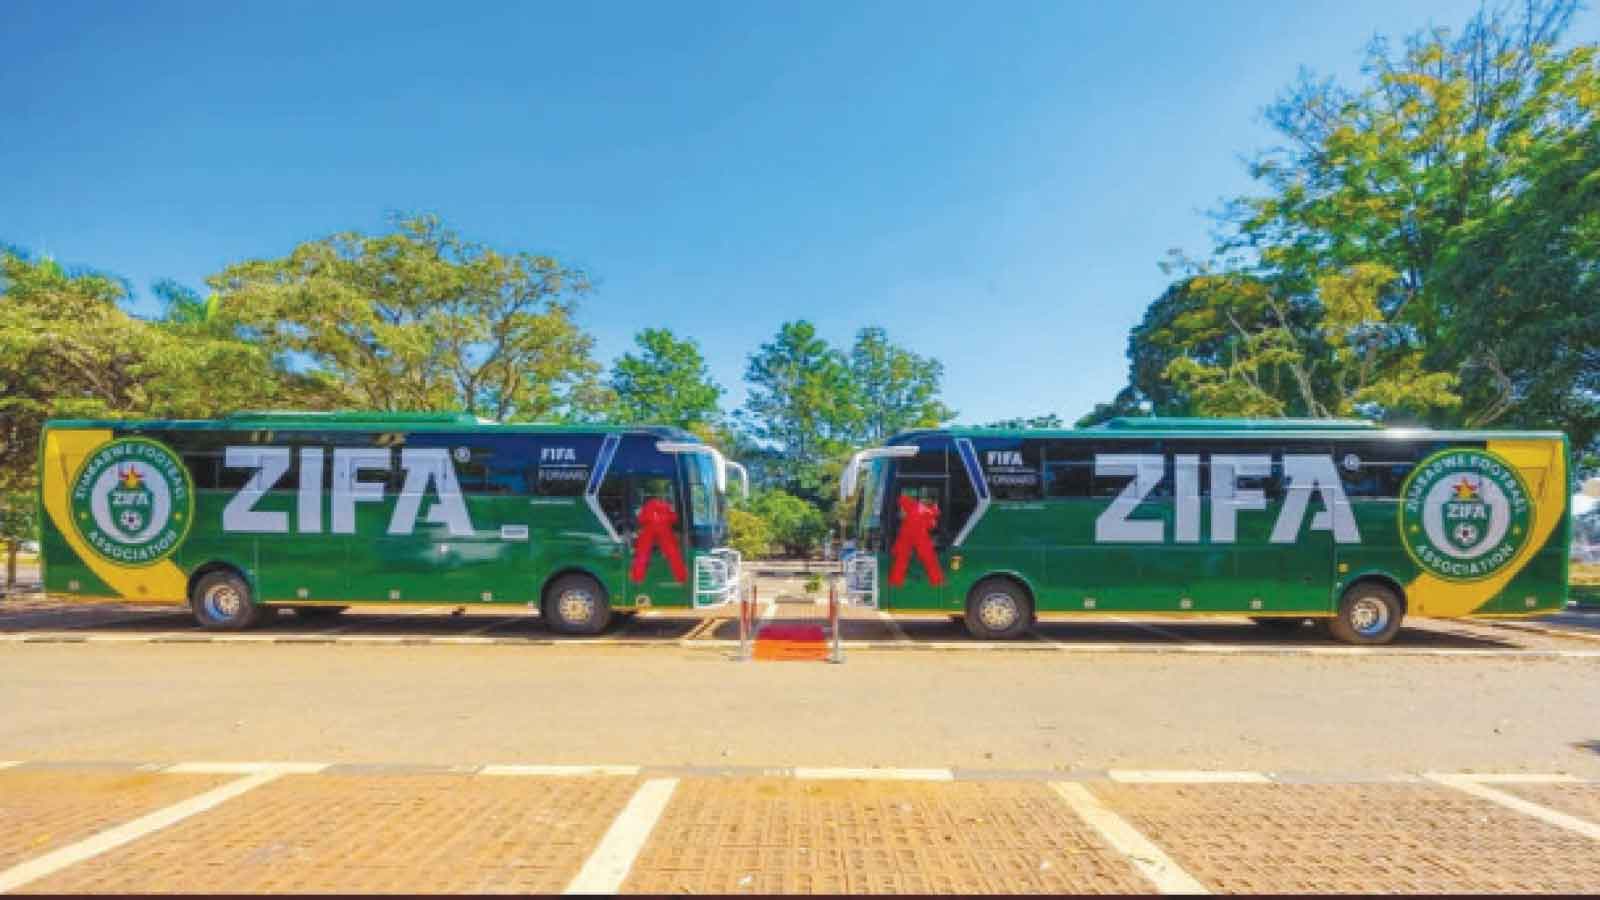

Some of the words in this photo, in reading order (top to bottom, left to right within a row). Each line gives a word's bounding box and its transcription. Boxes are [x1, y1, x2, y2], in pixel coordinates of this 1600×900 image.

[541, 447, 576, 461] FIFA
[987, 450, 1023, 465] FIFA
[112, 493, 148, 505] ZIFA
[1446, 503, 1486, 518] ZIFA
[1415, 544, 1514, 574] ASSOCIATION
